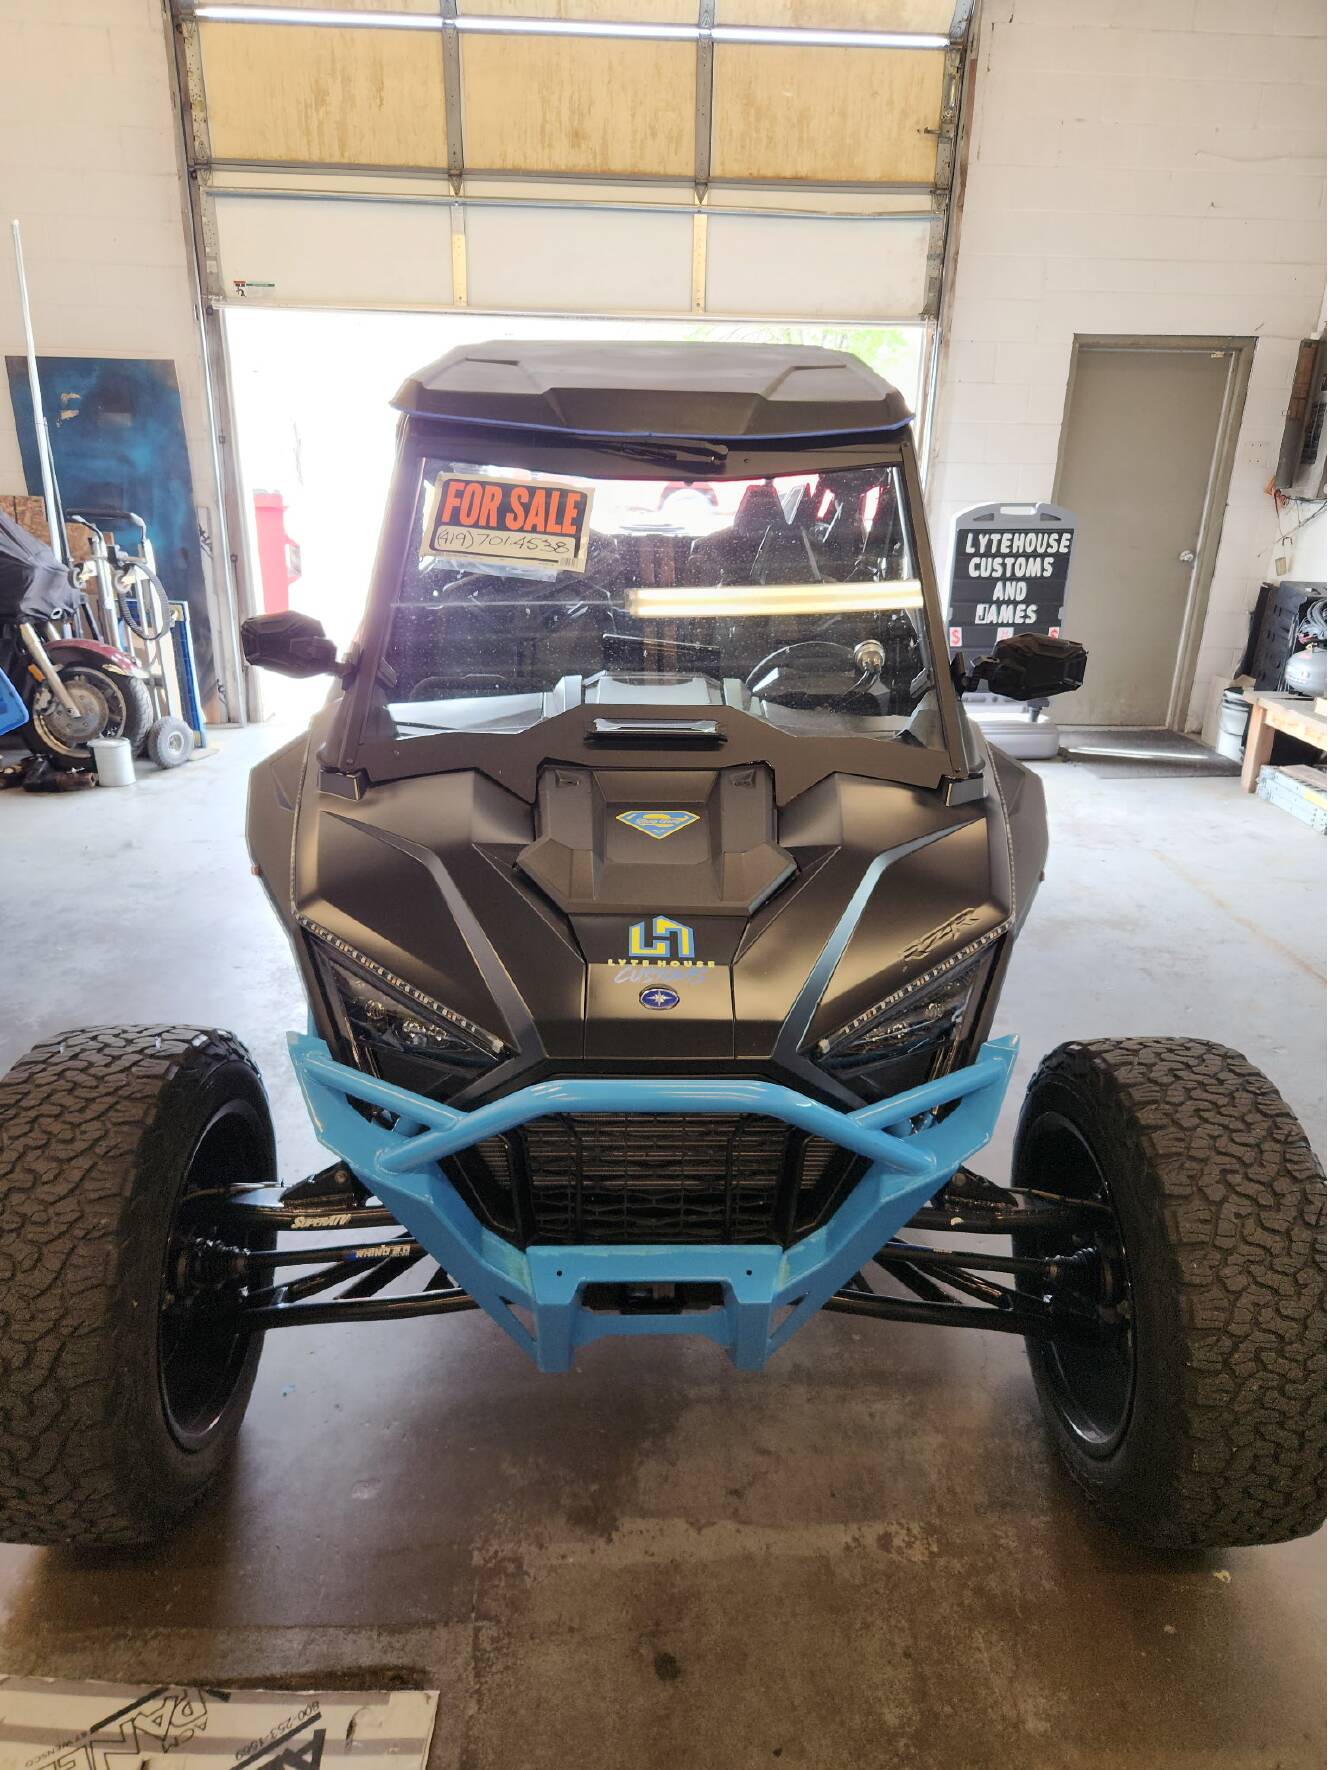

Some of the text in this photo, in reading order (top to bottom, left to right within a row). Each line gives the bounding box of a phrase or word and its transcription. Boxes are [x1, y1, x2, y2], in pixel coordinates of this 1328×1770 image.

[441, 481, 581, 535] FOR SALE
[437, 530, 474, 550] (419)
[965, 532, 1071, 553] LYTEHOUSE
[968, 557, 1054, 577] CUSTOMS
[993, 581, 1027, 601] AND
